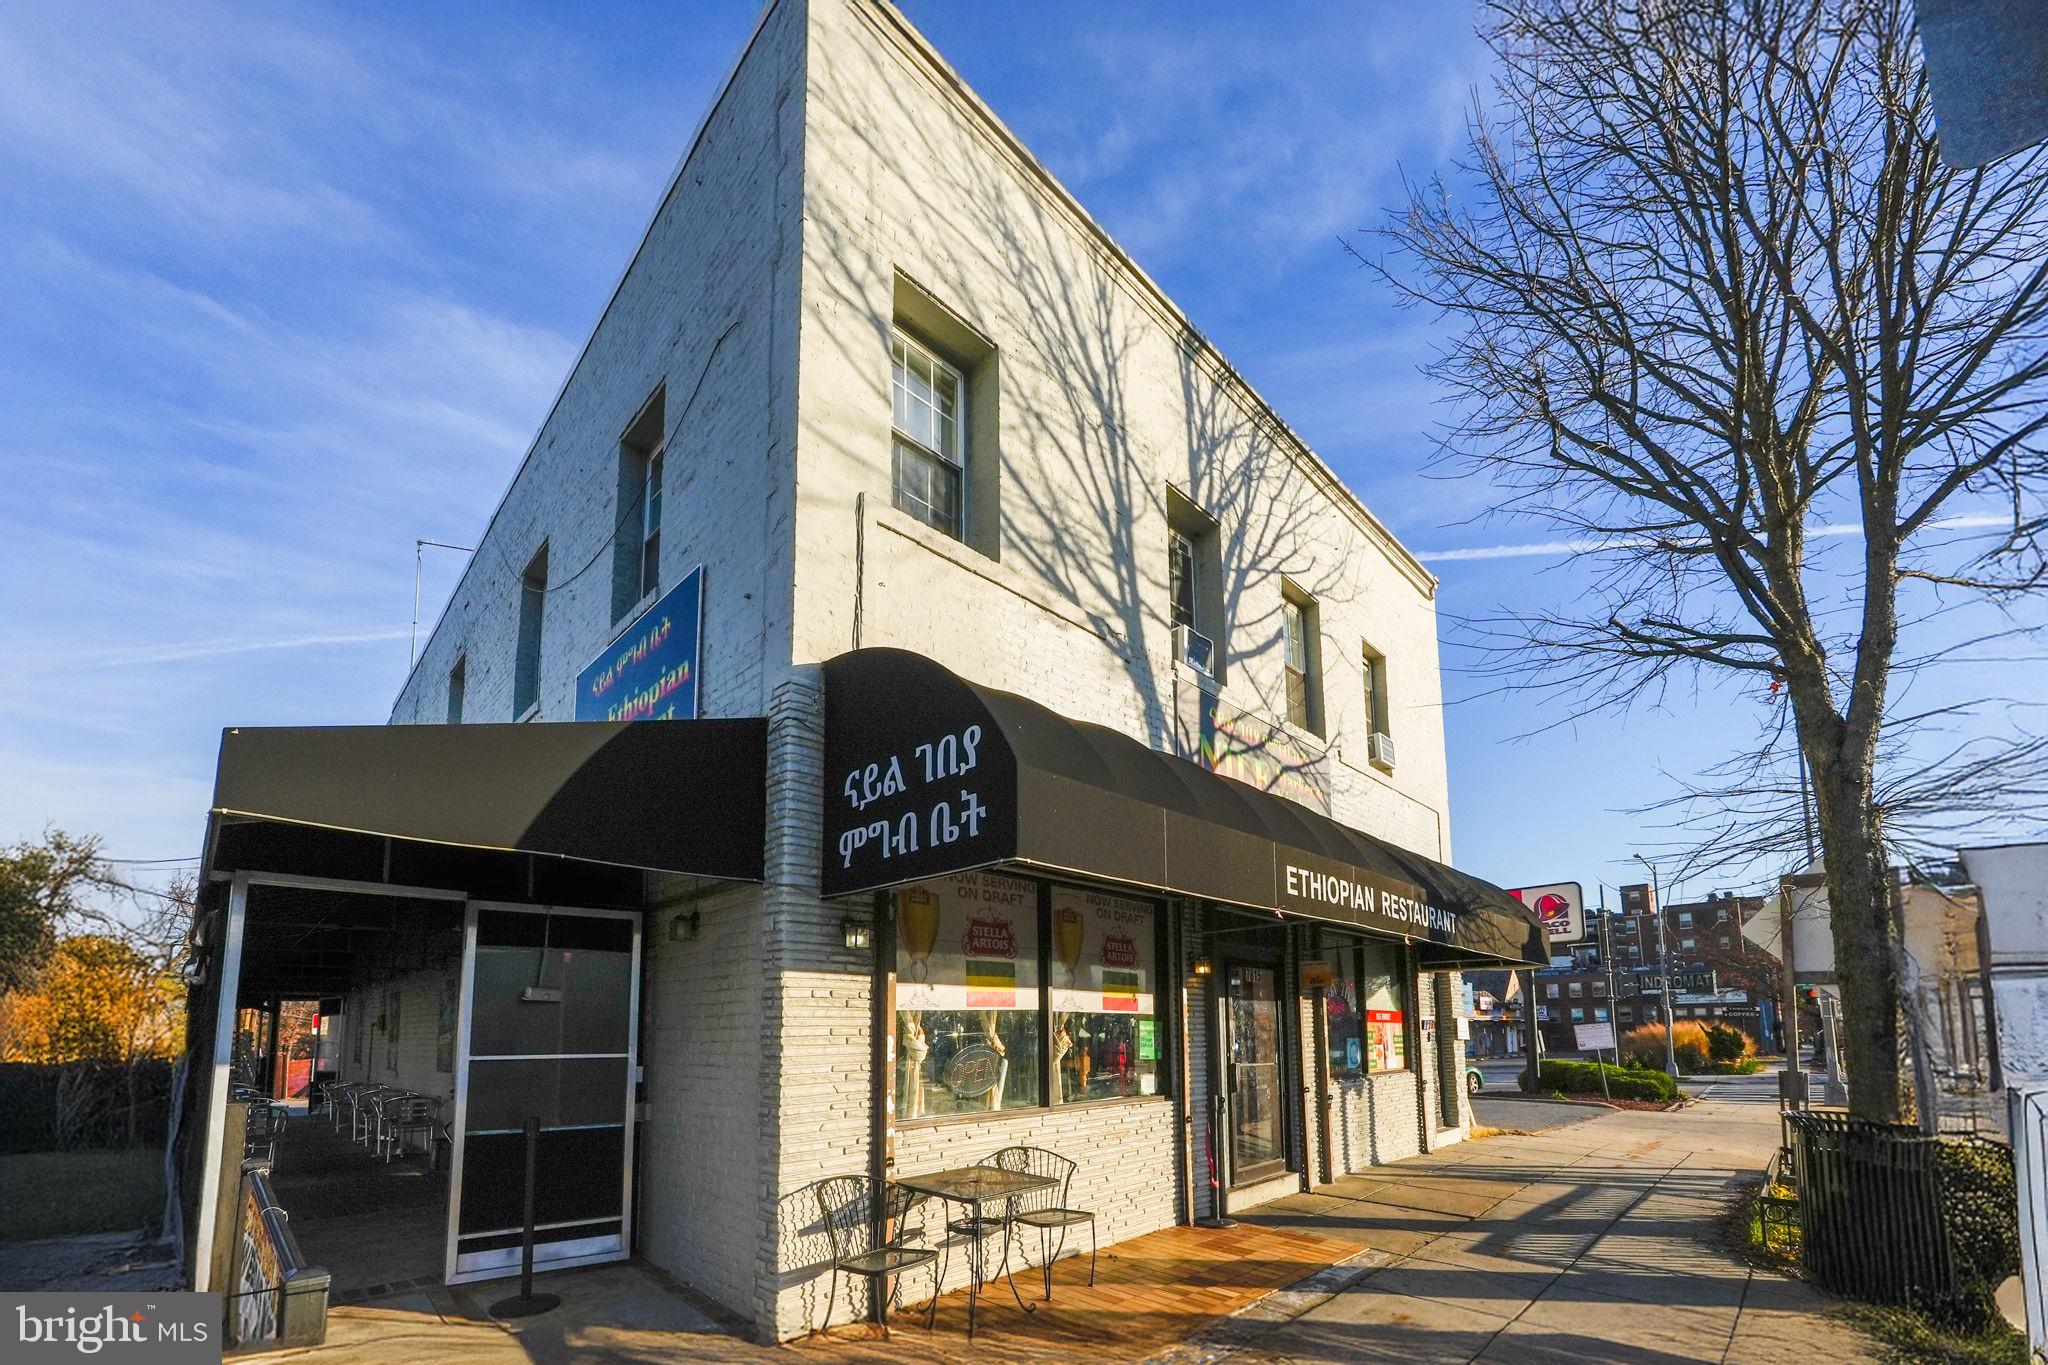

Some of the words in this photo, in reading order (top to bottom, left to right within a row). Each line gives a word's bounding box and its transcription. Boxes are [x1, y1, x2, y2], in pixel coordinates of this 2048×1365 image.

[608, 659, 690, 722] Ethiopian
[844, 755, 907, 811] ናይል
[914, 724, 982, 783] ገበያ
[838, 811, 919, 869] ምግብ
[929, 789, 987, 847] ቤት
[982, 875, 1036, 894] SERVING
[957, 886, 977, 901] ON
[982, 890, 1025, 906] DRAFT
[1086, 894, 1112, 907] NOW
[1113, 898, 1153, 916] SERVING
[1286, 865, 1375, 913] ETHIOPIAN
[1381, 890, 1456, 934] RESTAURANT
[1096, 908, 1112, 921] ON
[1114, 911, 1145, 925] DRAFT
[1544, 920, 1571, 928] ACO
[972, 925, 1009, 939] STELLA
[1549, 927, 1572, 935] ELL
[972, 937, 1010, 952] ARTOIS
[1106, 941, 1133, 954] STELLA
[1106, 951, 1134, 963] ARTOIS
[948, 1057, 998, 1089] OPEN
